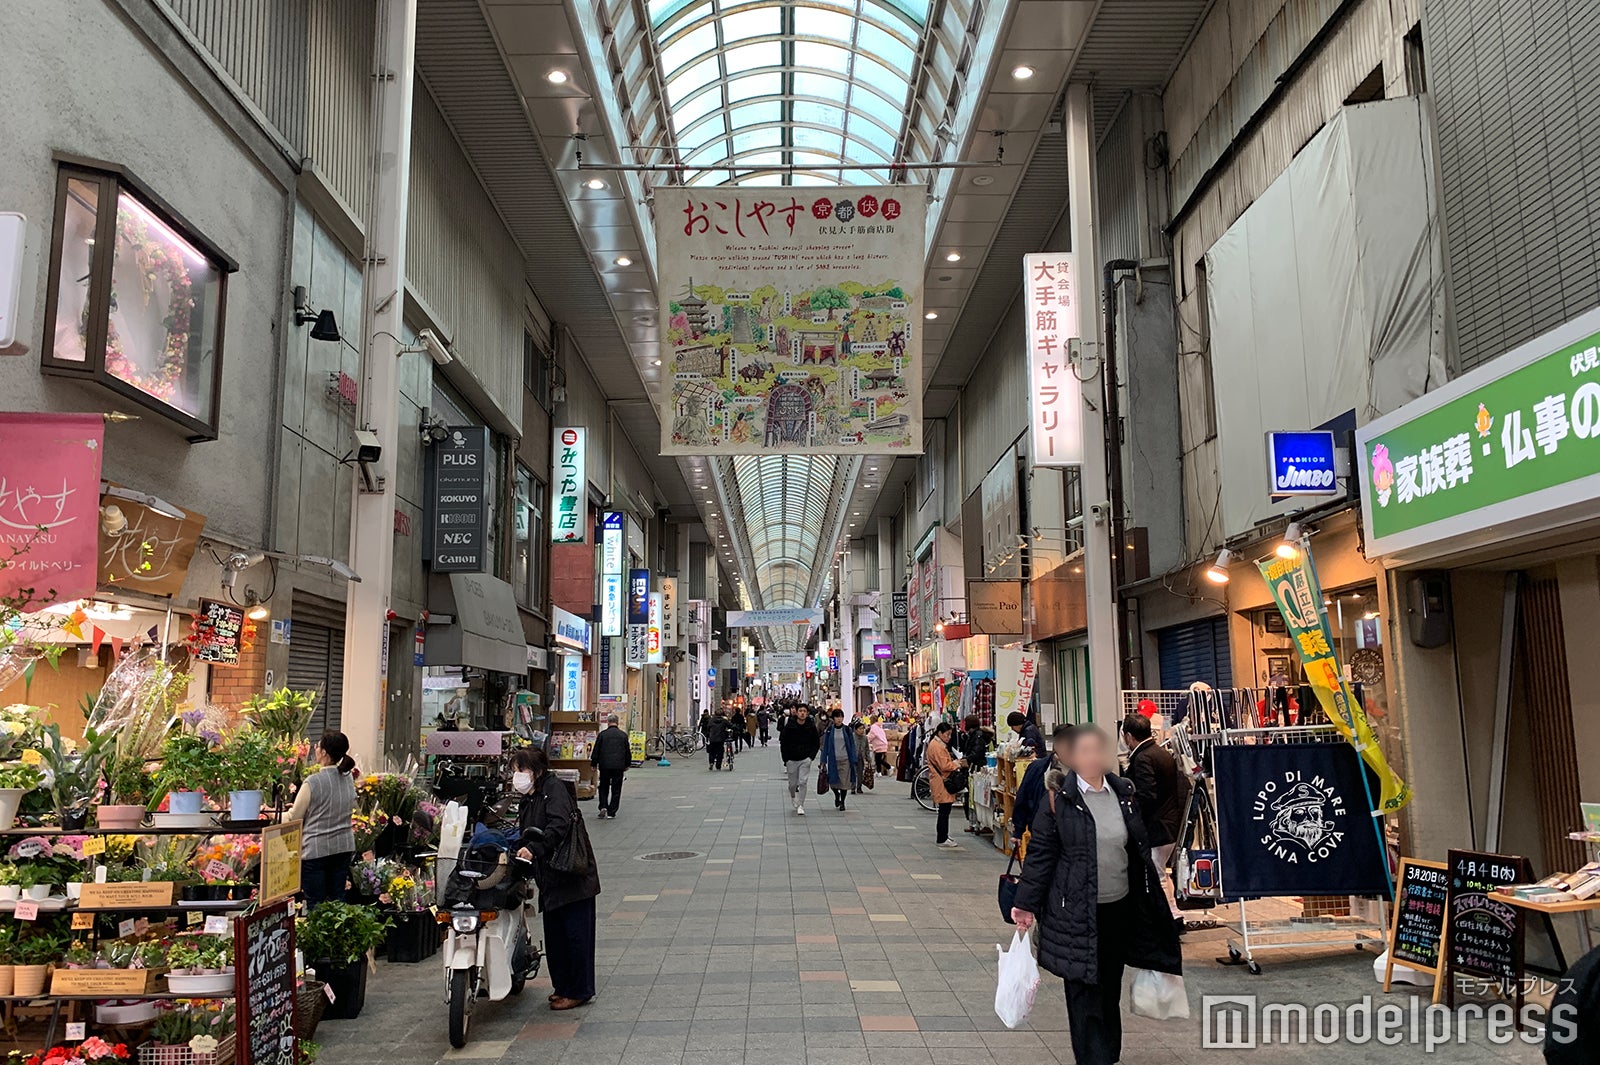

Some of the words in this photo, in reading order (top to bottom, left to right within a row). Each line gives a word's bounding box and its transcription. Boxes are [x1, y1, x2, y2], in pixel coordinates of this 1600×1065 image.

[683, 197, 804, 237] おこしやす
[813, 198, 900, 220] 京都伏見
[819, 225, 894, 235] 伏見大手筋商店街
[1056, 261, 1071, 308] 貸会場
[1034, 261, 1060, 457] 大手筋ギャラリー
[1570, 346, 1600, 377] 伏見
[443, 454, 477, 465] PLUS
[560, 447, 578, 529] みつや書店
[440, 513, 476, 524] RICOH
[443, 532, 472, 544] NEC
[7, 559, 82, 570] ワイルドベリー
[438, 554, 476, 564] Canon
[999, 602, 1018, 610] Pao
[630, 626, 638, 660] エディオン
[1253, 781, 1277, 820] LUPO
[1285, 770, 1301, 782] DI
[1311, 774, 1346, 816] MARE
[1260, 835, 1298, 864] SINA
[1308, 831, 1345, 862] COVA
